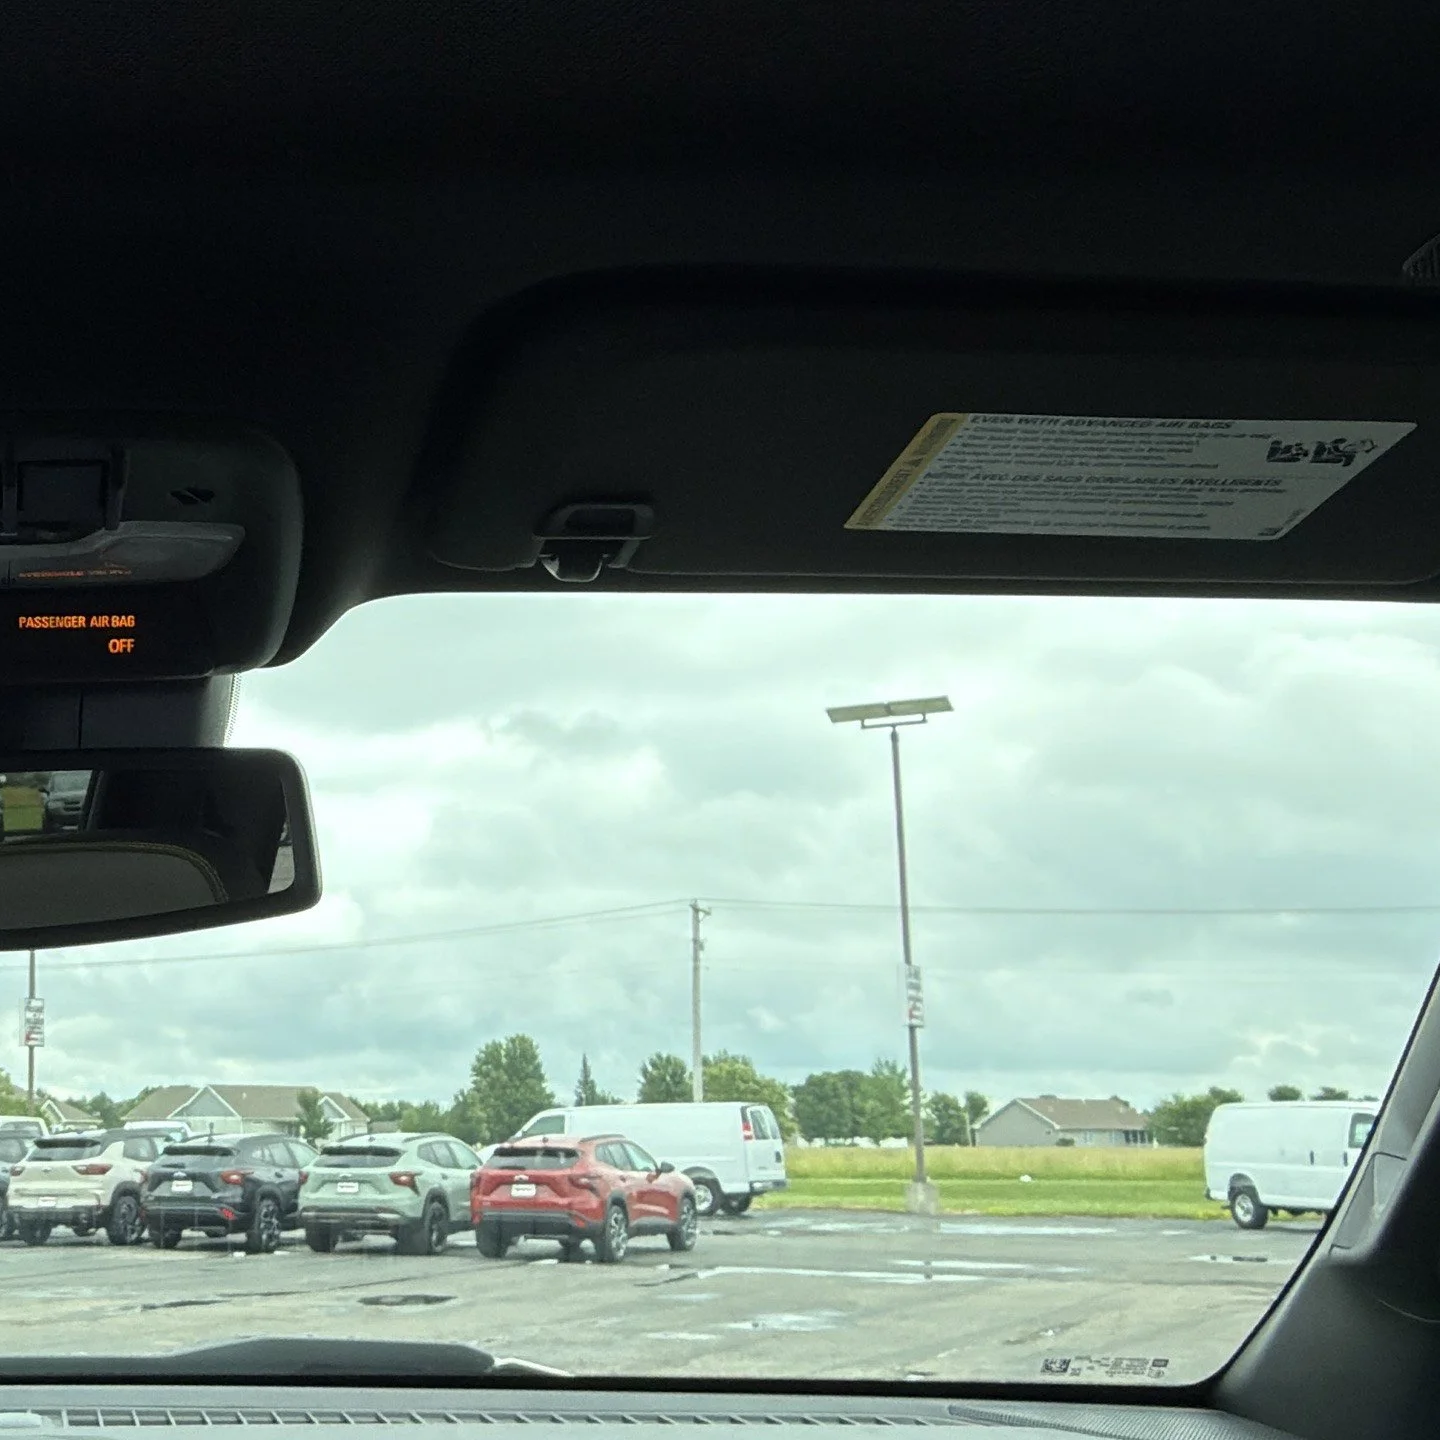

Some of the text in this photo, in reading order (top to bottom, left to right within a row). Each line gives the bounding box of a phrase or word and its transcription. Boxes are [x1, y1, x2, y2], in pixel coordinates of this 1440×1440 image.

[18, 615, 136, 629] PASSENGER AIR BAG
[108, 639, 135, 653] OFF
